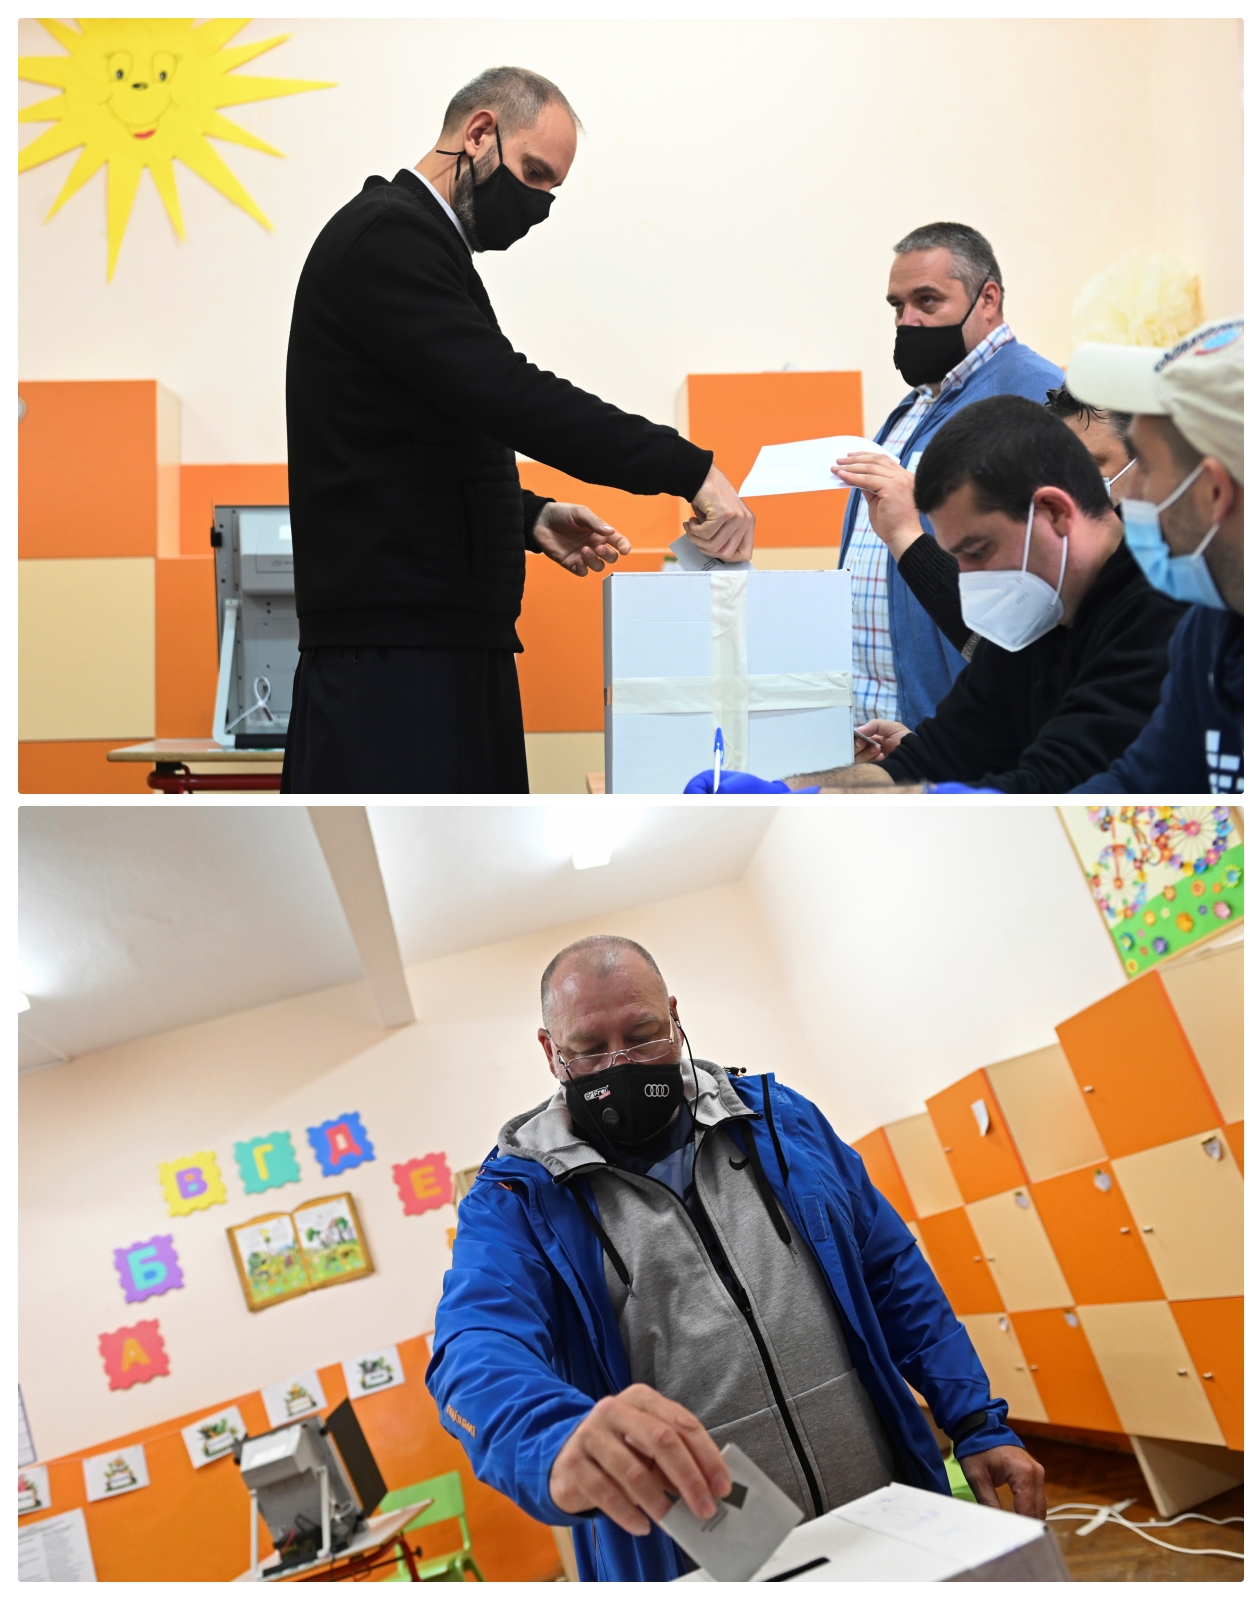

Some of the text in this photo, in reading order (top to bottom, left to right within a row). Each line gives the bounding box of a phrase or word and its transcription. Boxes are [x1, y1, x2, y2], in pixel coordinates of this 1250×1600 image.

[252, 1143, 274, 1181] Г
[325, 1121, 362, 1166] Д
[175, 1166, 208, 1200] В
[410, 1164, 442, 1199] Е
[127, 1245, 168, 1291] Б
[121, 1335, 150, 1373] А
